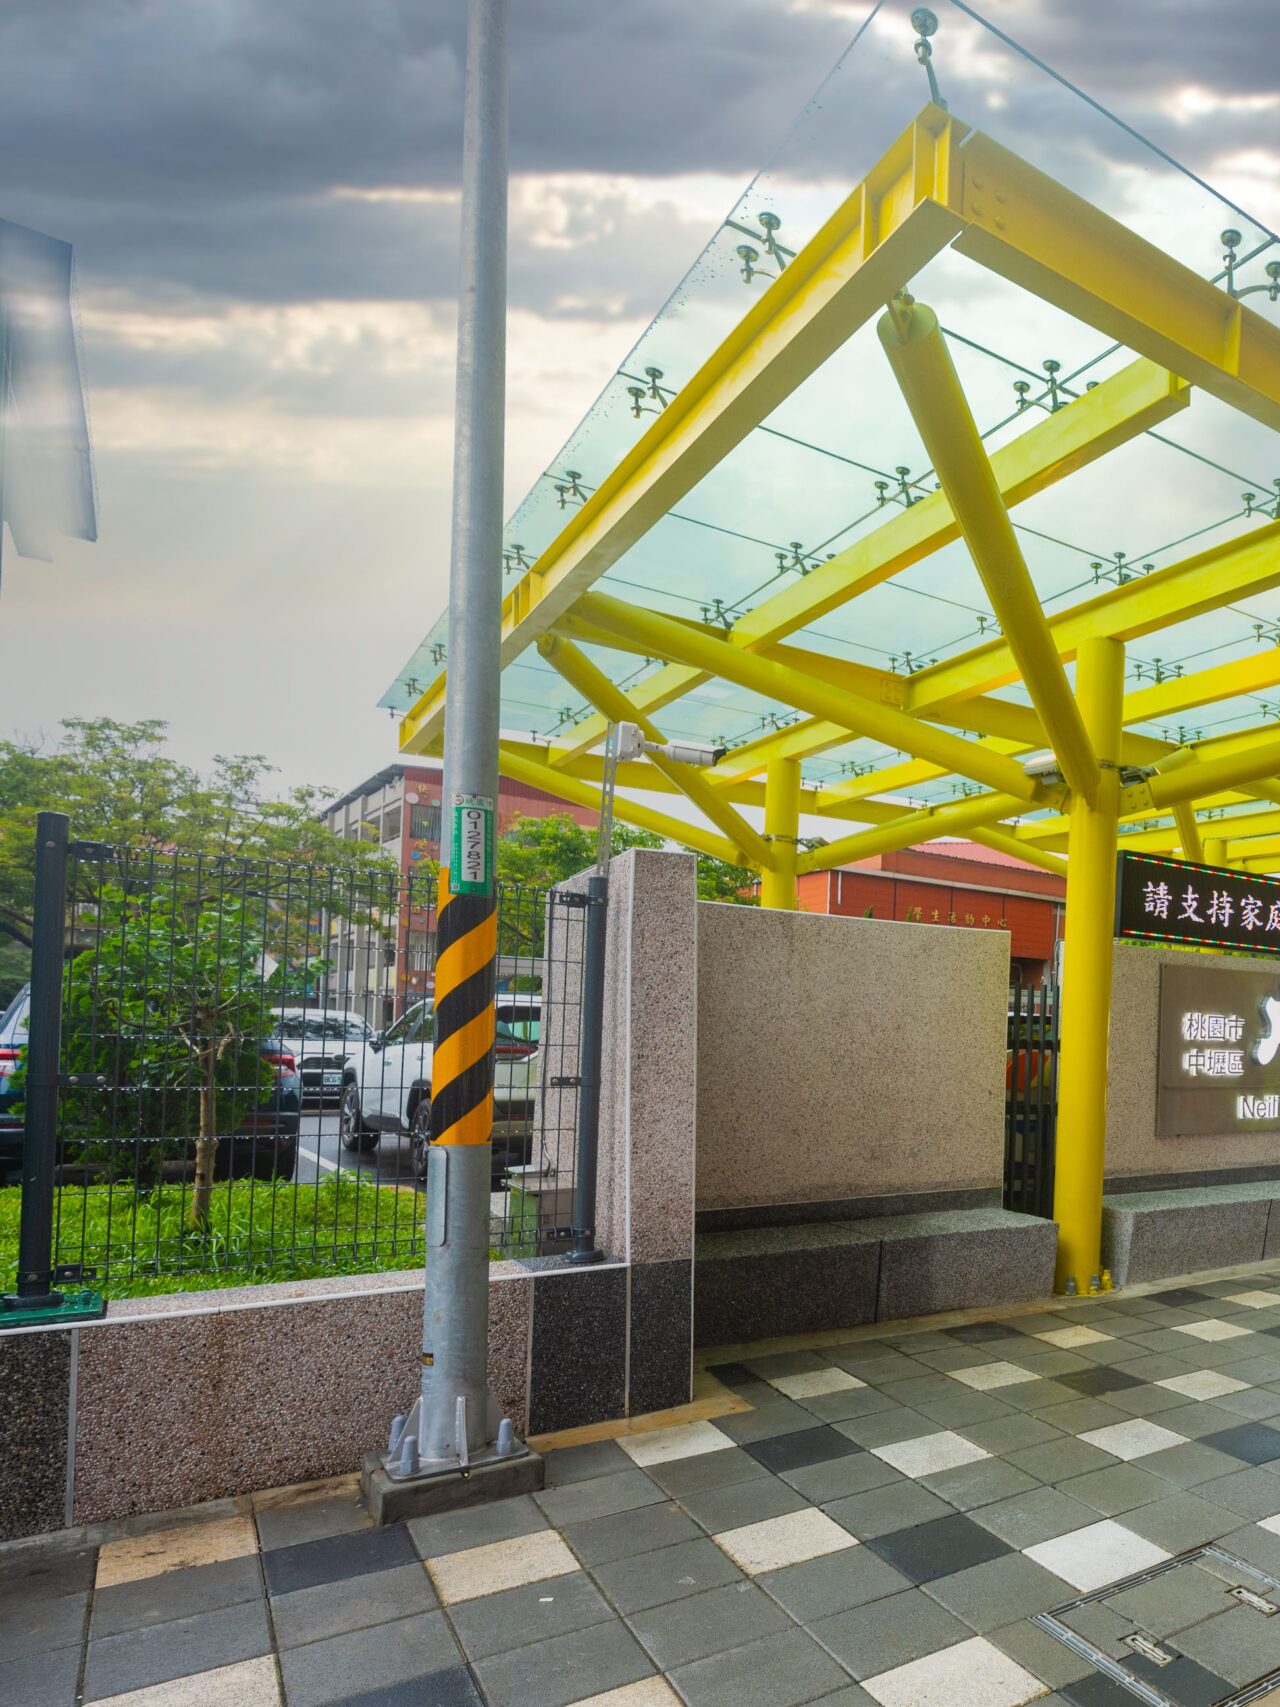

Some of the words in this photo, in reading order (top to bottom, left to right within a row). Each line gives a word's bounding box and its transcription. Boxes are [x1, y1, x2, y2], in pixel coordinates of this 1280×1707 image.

[467, 810, 481, 881] 0127821
[1182, 1013, 1245, 1041] 桃園市
[1183, 1049, 1245, 1076] 中壢區
[1237, 1095, 1279, 1120] Neili
